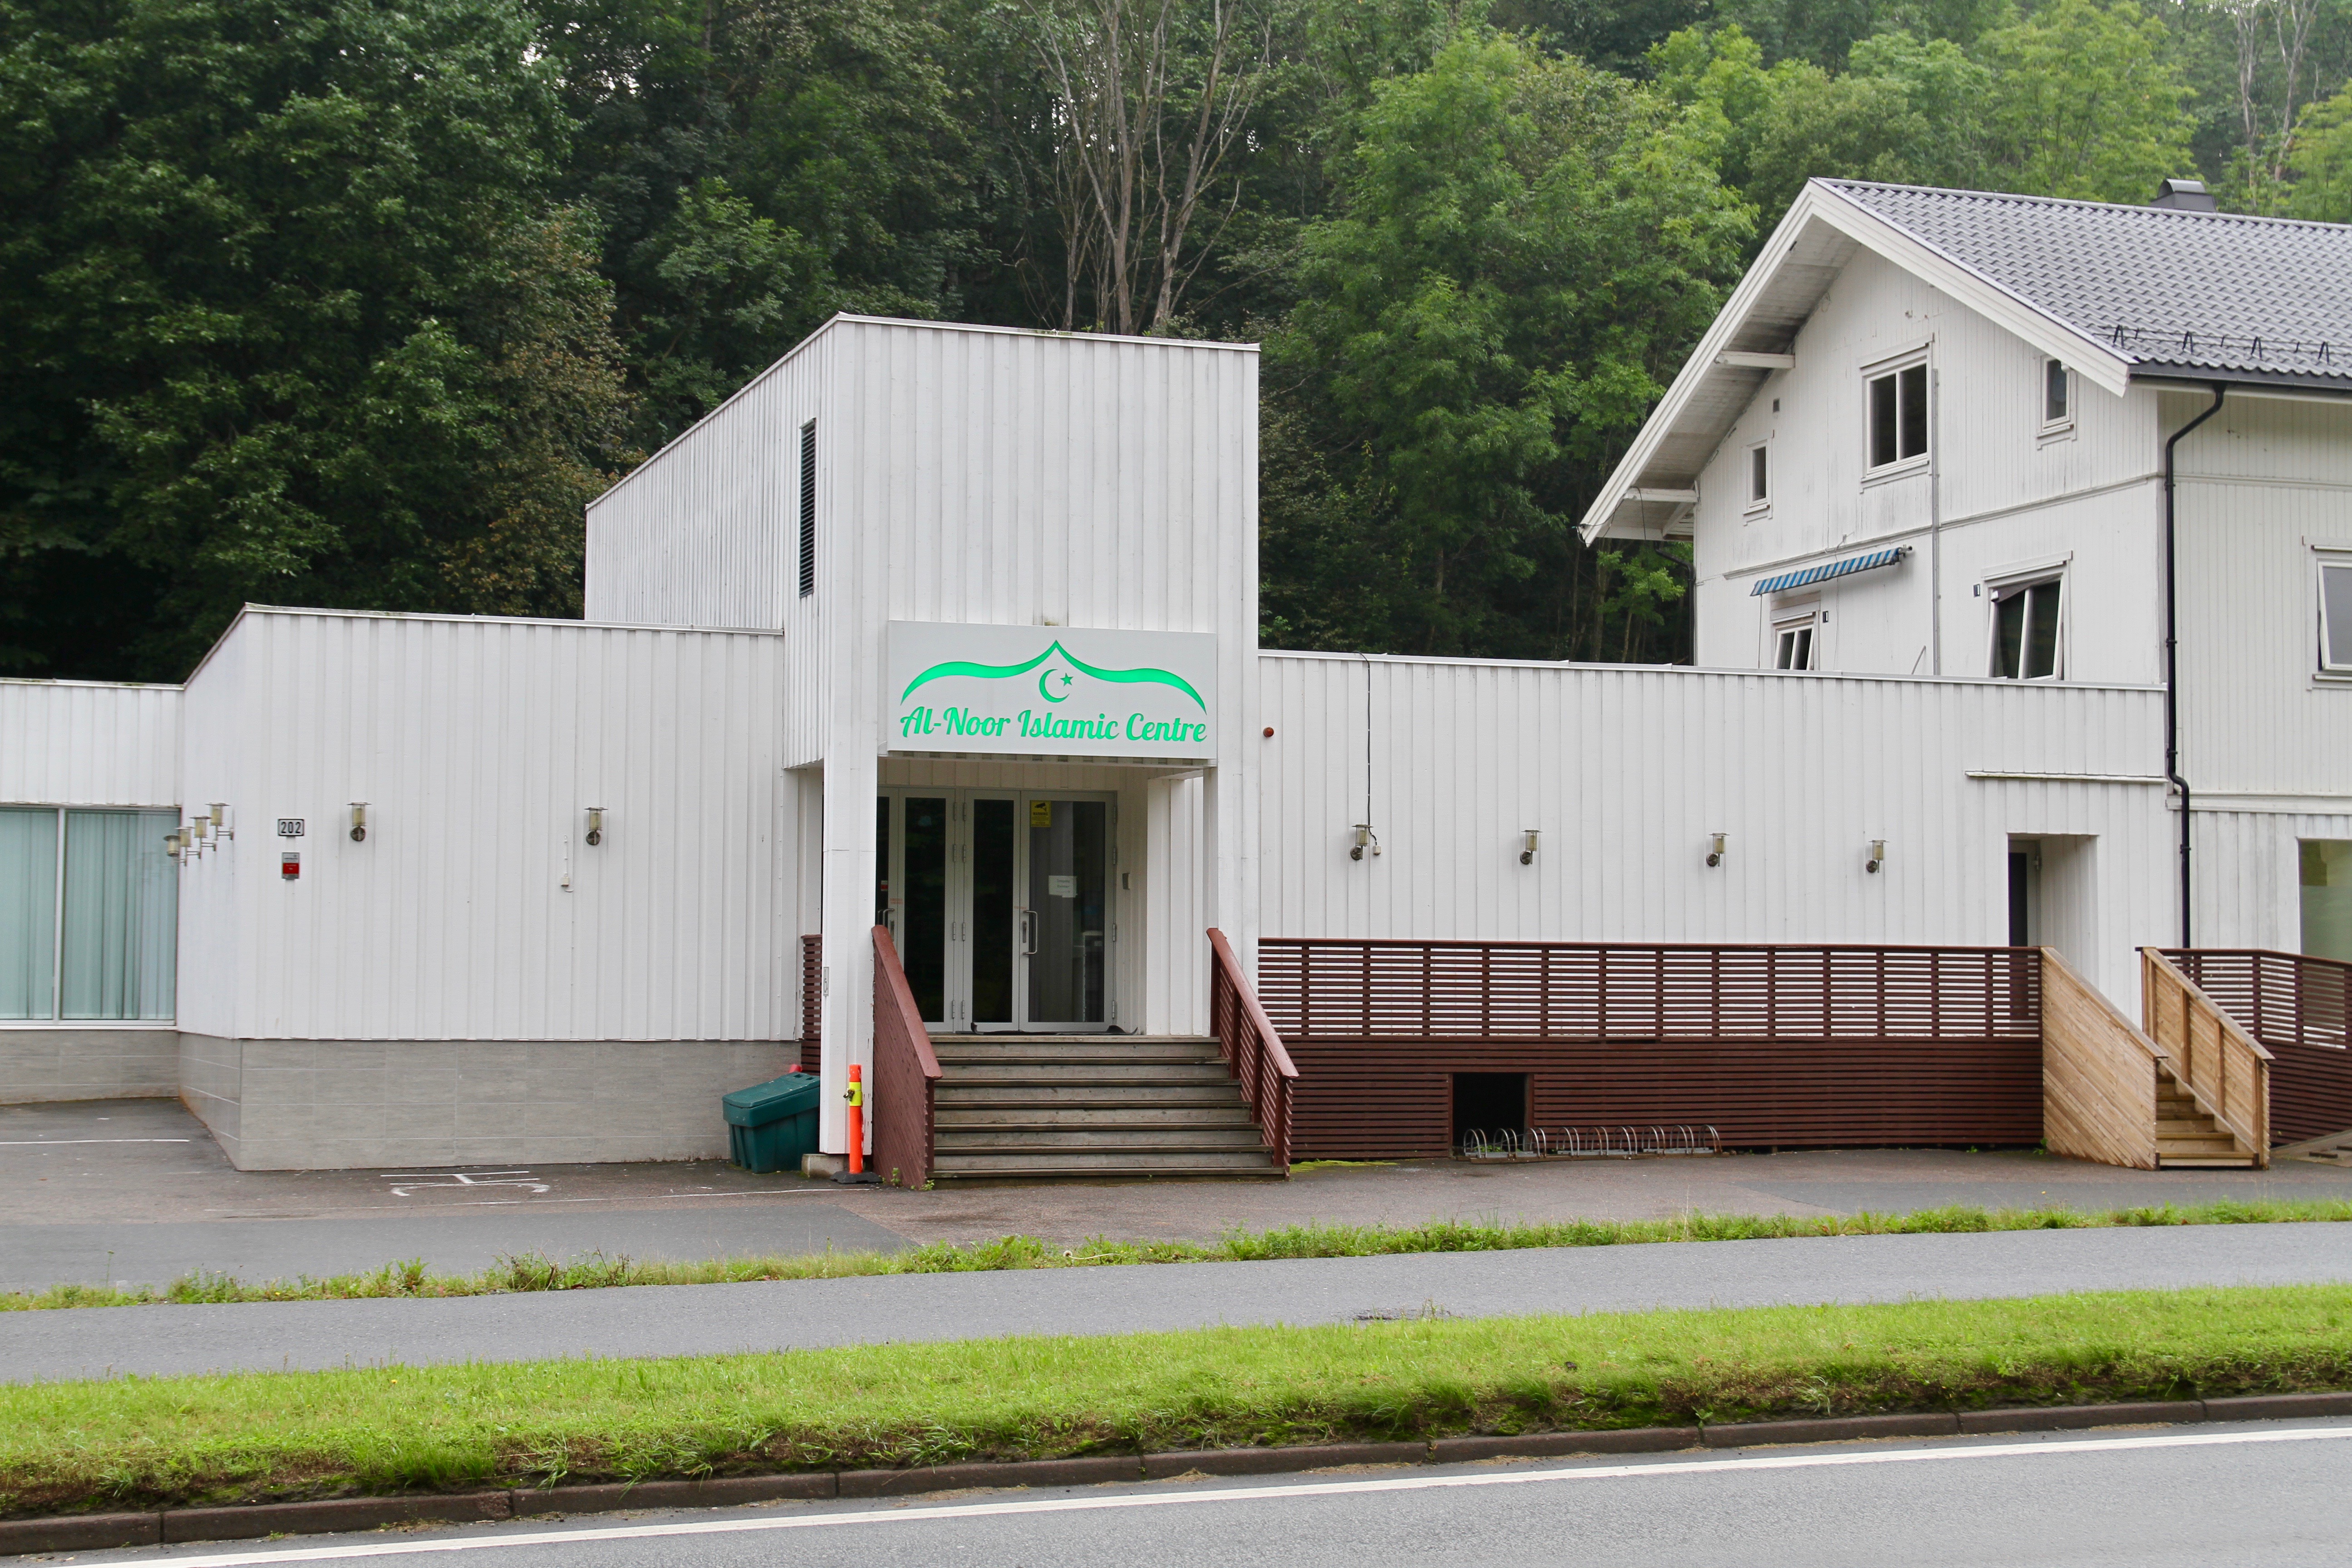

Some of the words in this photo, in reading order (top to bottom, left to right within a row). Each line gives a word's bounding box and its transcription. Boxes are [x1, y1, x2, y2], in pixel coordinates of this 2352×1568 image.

[900, 706, 1011, 738] Al-Noor
[1017, 709, 1119, 740] Islamic
[1125, 713, 1207, 742] Centre
[281, 822, 301, 833] 202
